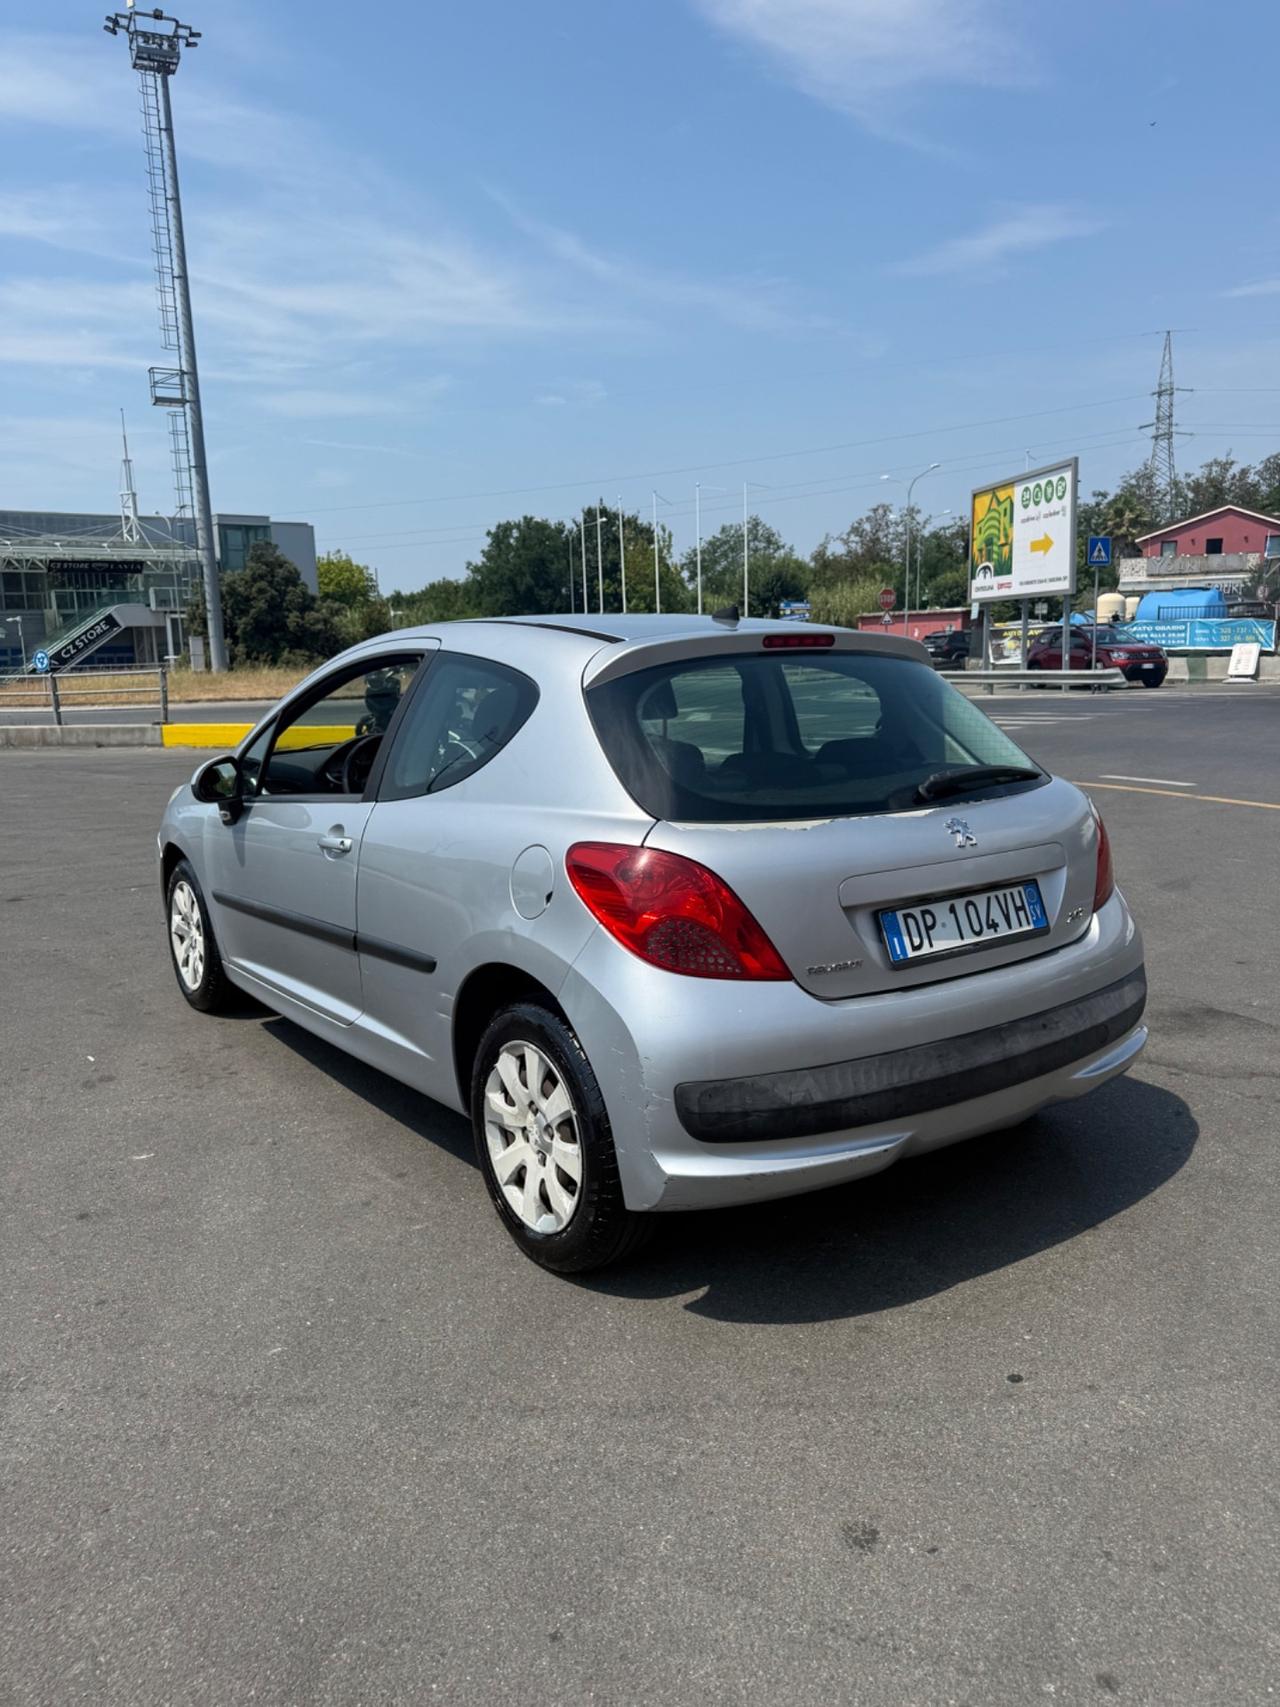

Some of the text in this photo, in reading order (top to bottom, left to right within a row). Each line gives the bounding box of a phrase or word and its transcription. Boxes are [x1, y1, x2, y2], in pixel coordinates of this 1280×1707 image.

[61, 620, 111, 659] CZ STORE
[902, 908, 938, 953] DP
[949, 889, 1031, 941] 104VH
